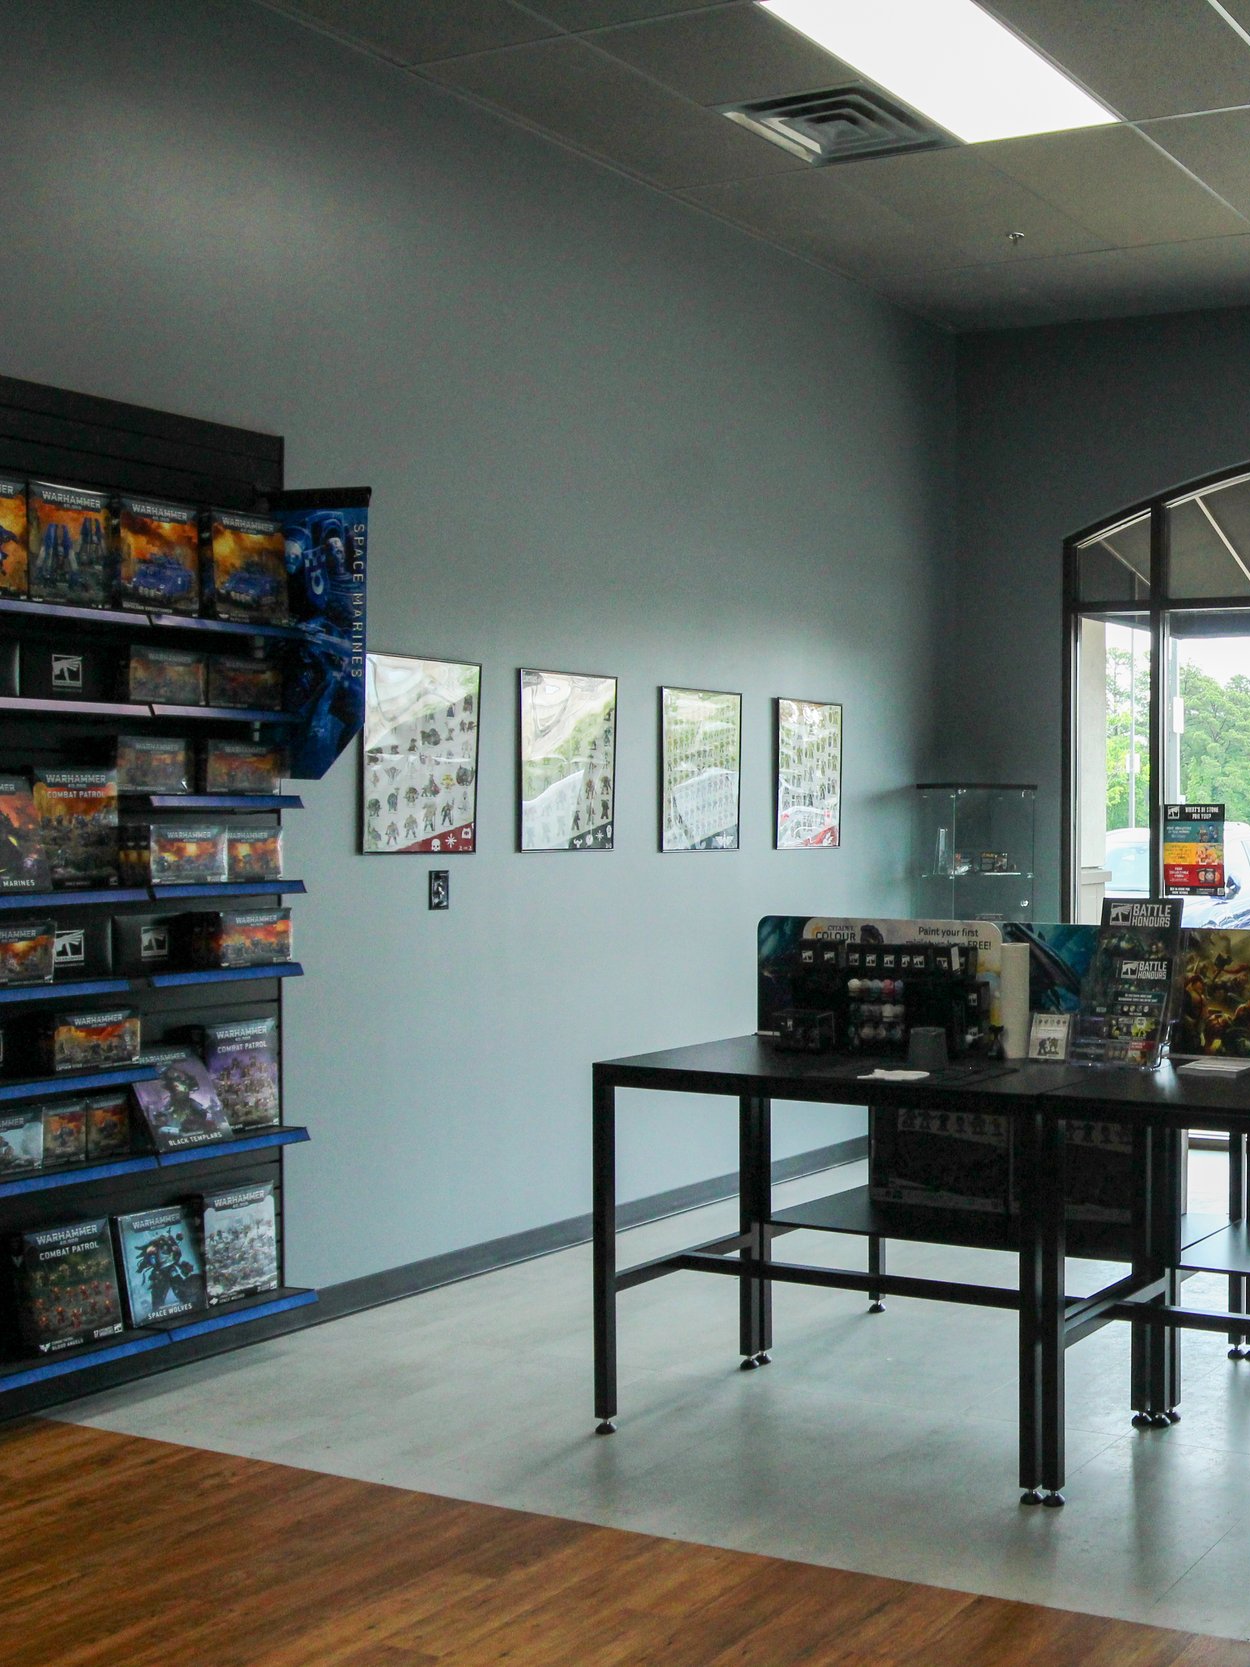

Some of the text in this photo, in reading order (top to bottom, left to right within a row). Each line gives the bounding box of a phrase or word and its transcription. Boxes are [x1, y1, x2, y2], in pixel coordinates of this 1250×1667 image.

[42, 490, 101, 509] WARHAMMER
[132, 503, 187, 521] WARHAMMER
[222, 516, 274, 533] WARHAMMER
[352, 524, 365, 678] SPACE MARINES
[46, 774, 106, 784] WARHAMMER
[3, 879, 35, 887] MARINES
[1133, 903, 1172, 917] BATTLE
[235, 914, 278, 924] WARHAMMER
[1131, 917, 1170, 928] HONOURS
[918, 926, 978, 938] Paint your first
[967, 940, 991, 950] FREE!
[1139, 961, 1168, 971] BATTLE
[1138, 971, 1167, 980] HONOURS
[74, 1014, 123, 1025] WARHAMMER
[216, 1026, 268, 1040] WARHAMMER
[217, 1041, 268, 1053] COMBAT PATROL
[168, 1131, 223, 1147] BLACK TEMPLARS
[214, 1190, 265, 1208] WARHAMMER
[132, 1212, 180, 1229] WARHAMMER
[36, 1224, 98, 1245] WARHAMMER
[40, 1240, 100, 1260] COMBAT PATROL
[147, 1302, 193, 1320] SPACE WOLVES
